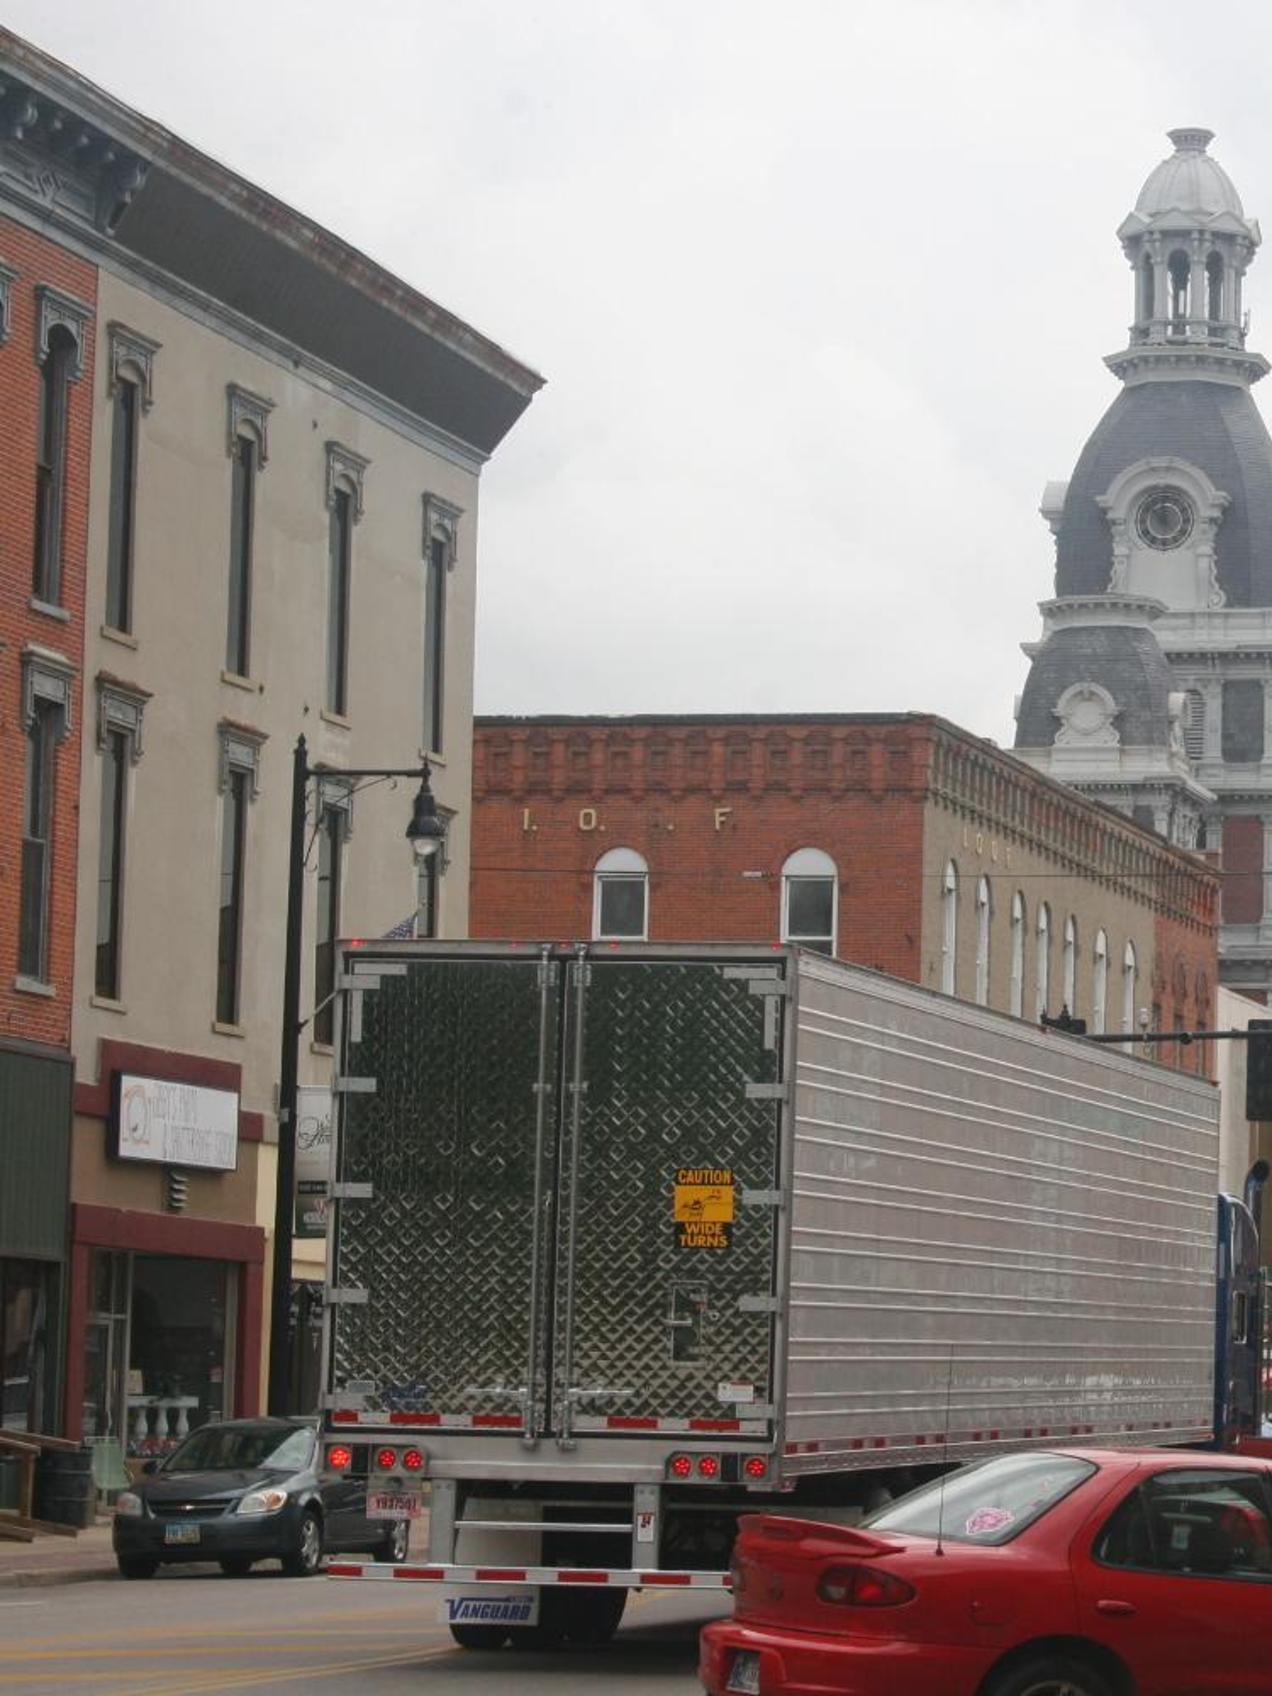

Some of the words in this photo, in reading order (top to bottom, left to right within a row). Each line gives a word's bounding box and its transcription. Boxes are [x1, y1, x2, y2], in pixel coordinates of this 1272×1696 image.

[678, 1169, 732, 1184] CAUTION
[685, 1222, 723, 1235] WIDE
[679, 1234, 728, 1247] TURNS
[446, 1598, 532, 1621] VANGUARD
